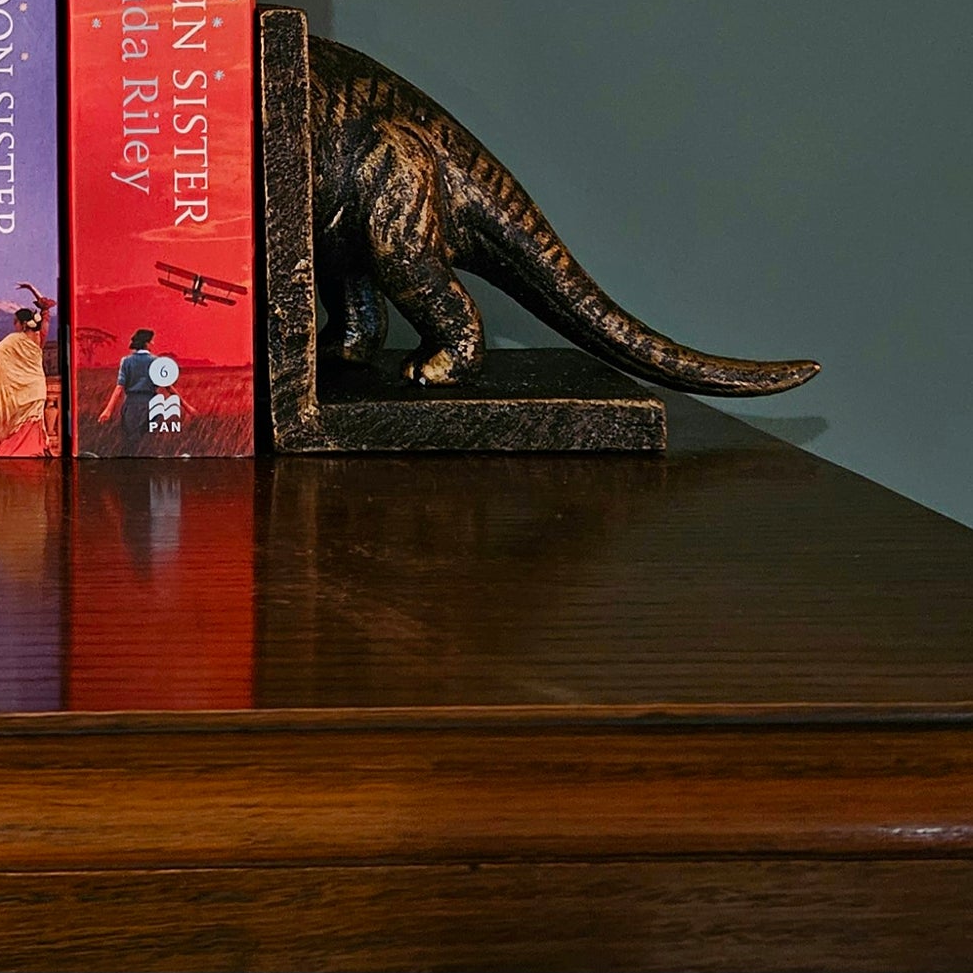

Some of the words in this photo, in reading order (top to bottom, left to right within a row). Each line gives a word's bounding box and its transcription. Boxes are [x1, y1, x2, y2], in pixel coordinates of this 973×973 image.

[111, 76, 160, 195] Riley
[172, 69, 209, 226] SISTER
[159, 366, 169, 378] 6
[149, 421, 181, 433] PAN
